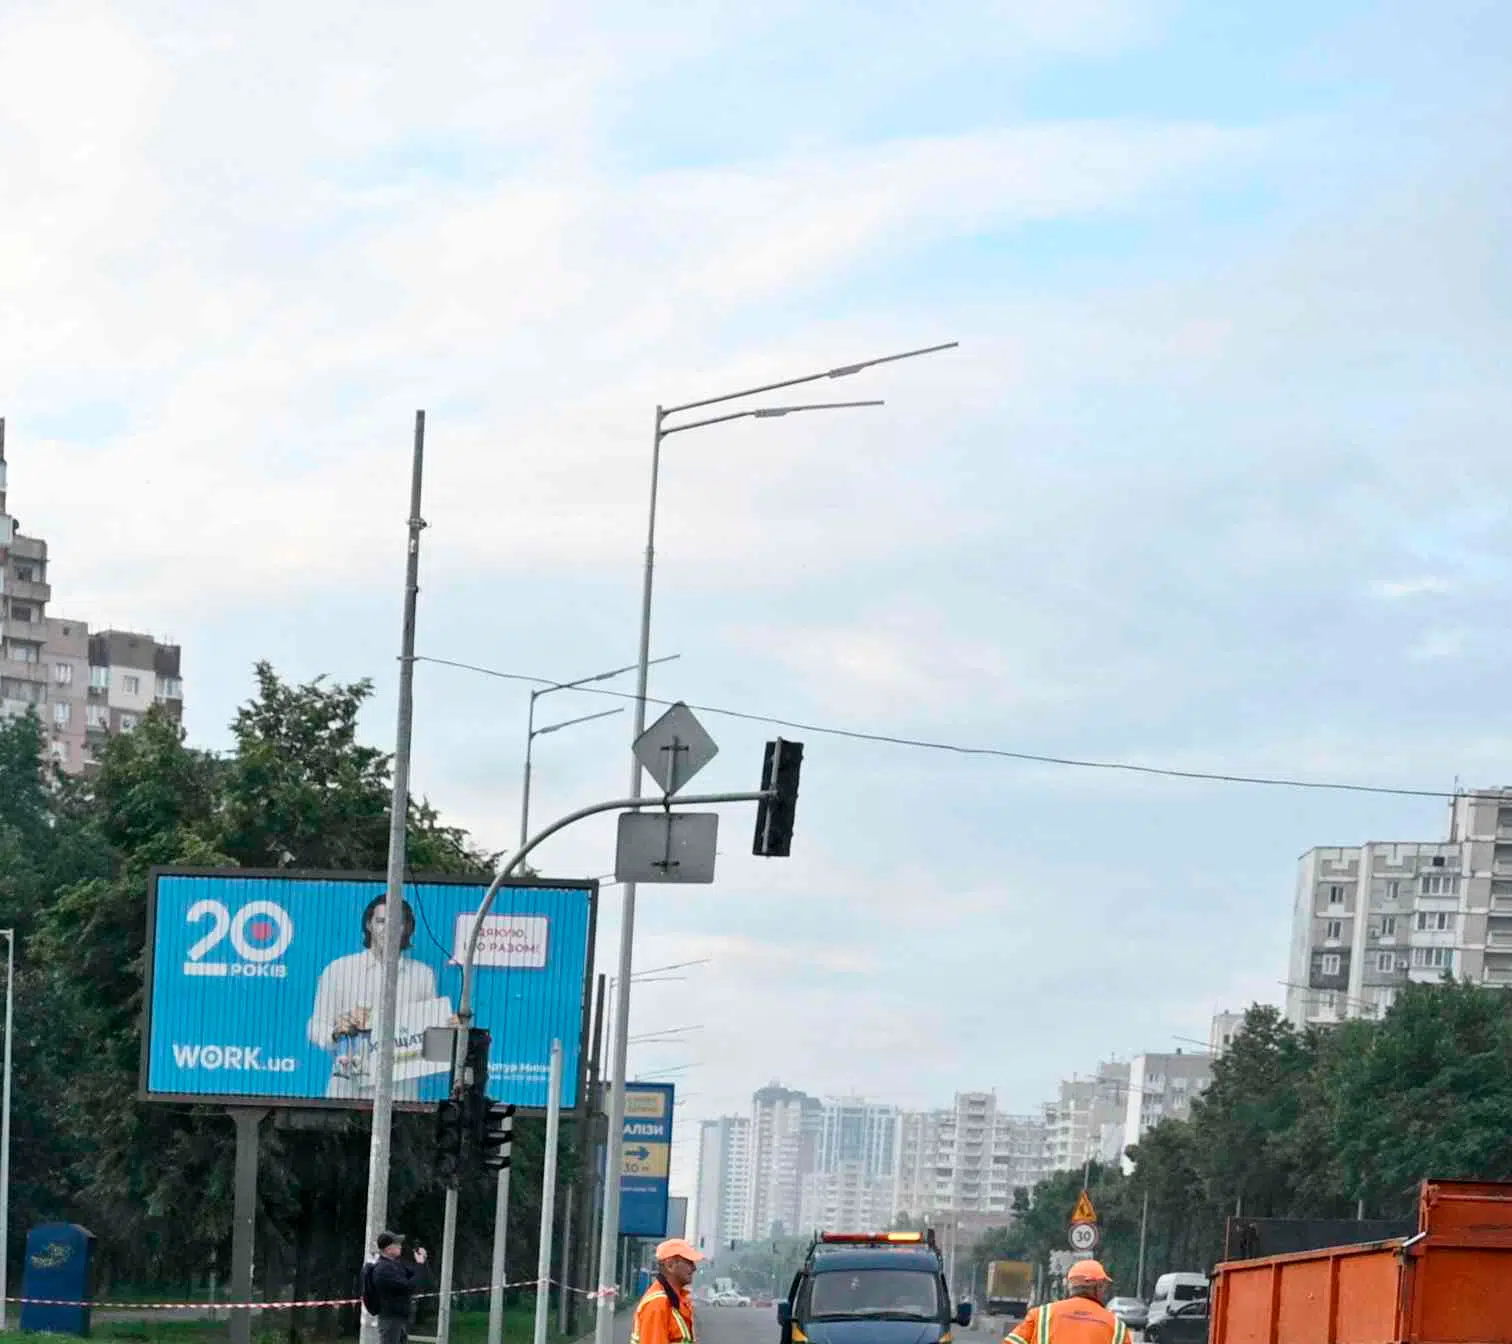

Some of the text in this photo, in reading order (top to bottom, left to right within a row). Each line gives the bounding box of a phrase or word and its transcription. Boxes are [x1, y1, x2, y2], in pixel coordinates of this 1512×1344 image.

[186, 899, 294, 963] 20
[230, 963, 288, 977] РОКІВ
[173, 1044, 296, 1072] WORK.ua
[1076, 1231, 1092, 1242] 30
